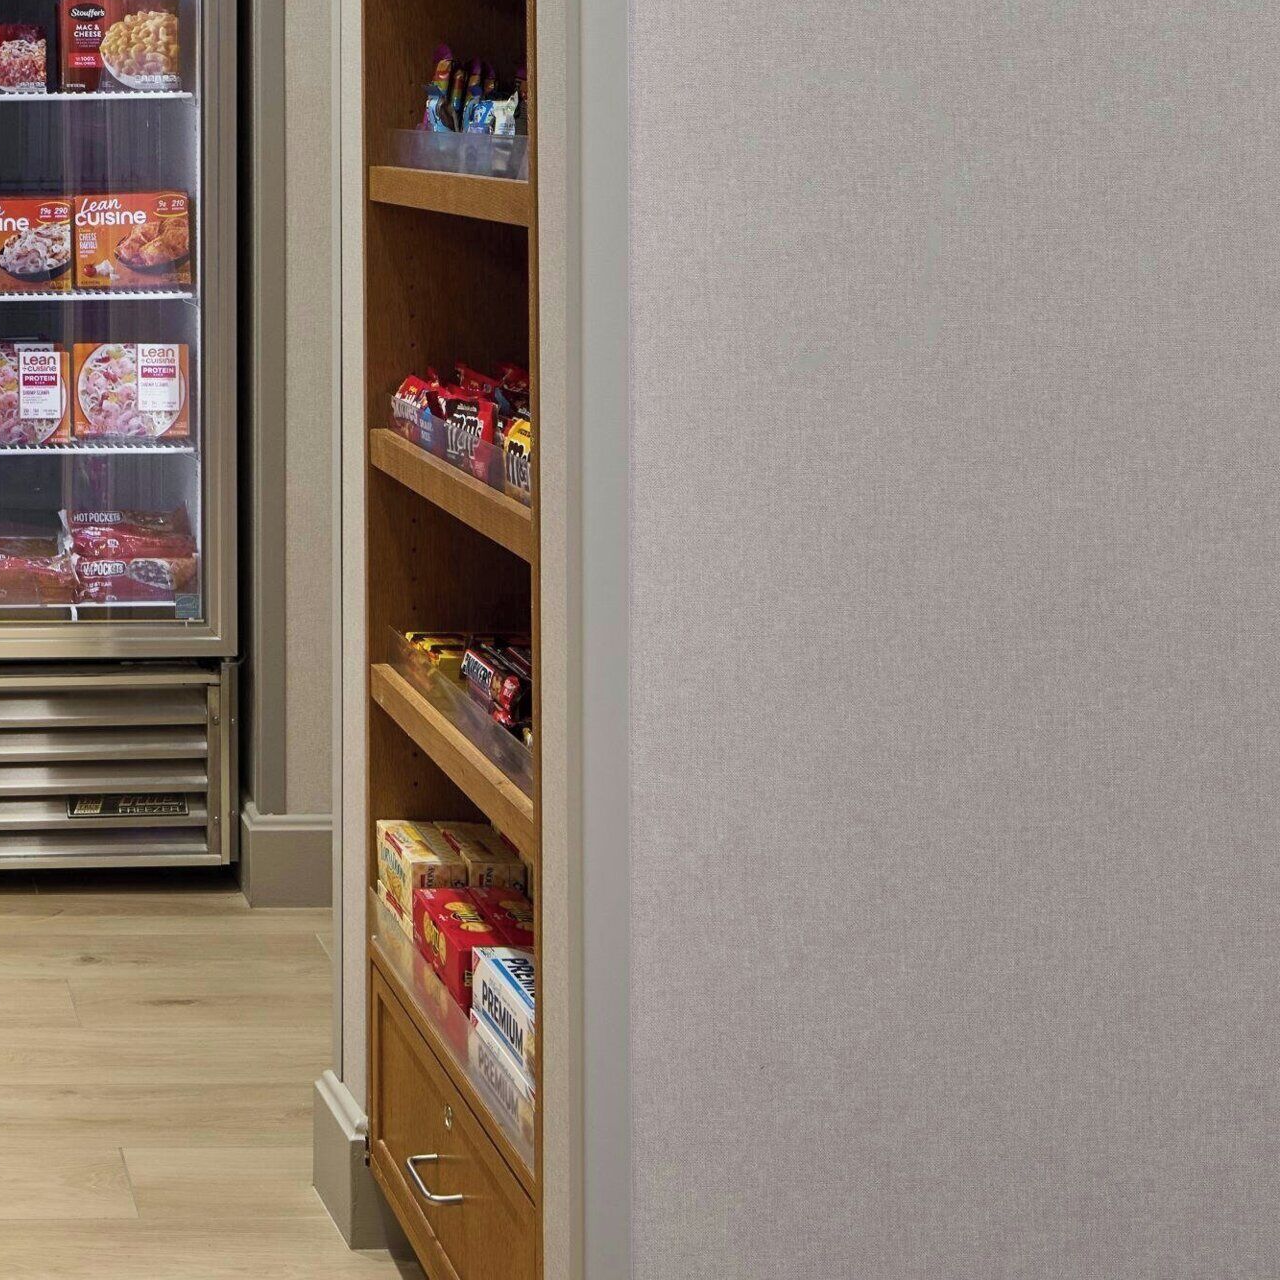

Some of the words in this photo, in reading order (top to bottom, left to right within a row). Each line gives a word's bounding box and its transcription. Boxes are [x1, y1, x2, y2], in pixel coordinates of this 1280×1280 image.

[71, 7, 105, 19] Stouffer's
[80, 198, 122, 214] Lean
[89, 512, 121, 523] POCKETS
[118, 806, 180, 814] FREEZER
[481, 979, 524, 1057] PREMIUM
